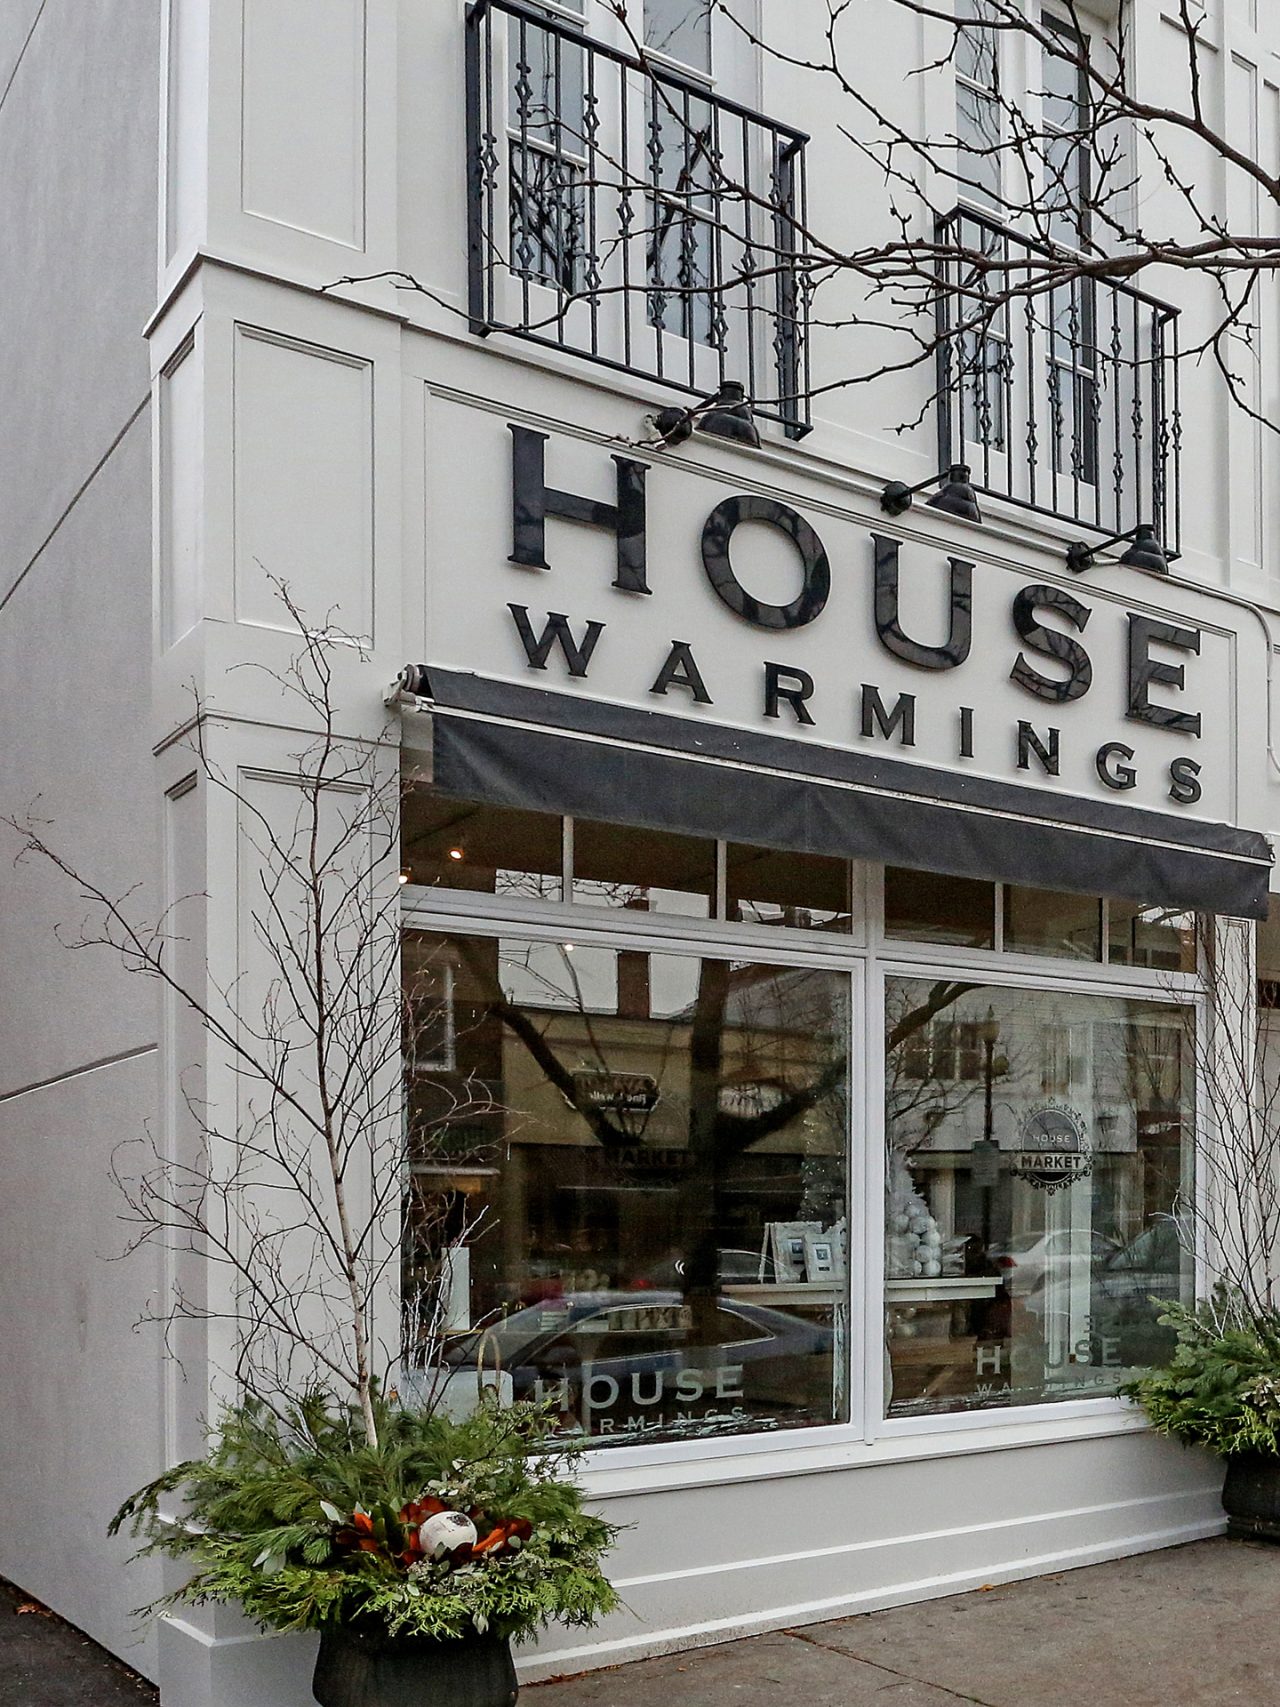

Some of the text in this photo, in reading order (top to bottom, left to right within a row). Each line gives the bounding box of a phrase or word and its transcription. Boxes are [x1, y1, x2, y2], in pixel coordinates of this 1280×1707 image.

[507, 423, 1201, 739] HOUSE
[507, 603, 1201, 804] WARMINGS
[1021, 1156, 1081, 1168] MARKET
[534, 1364, 744, 1412] HOUSE
